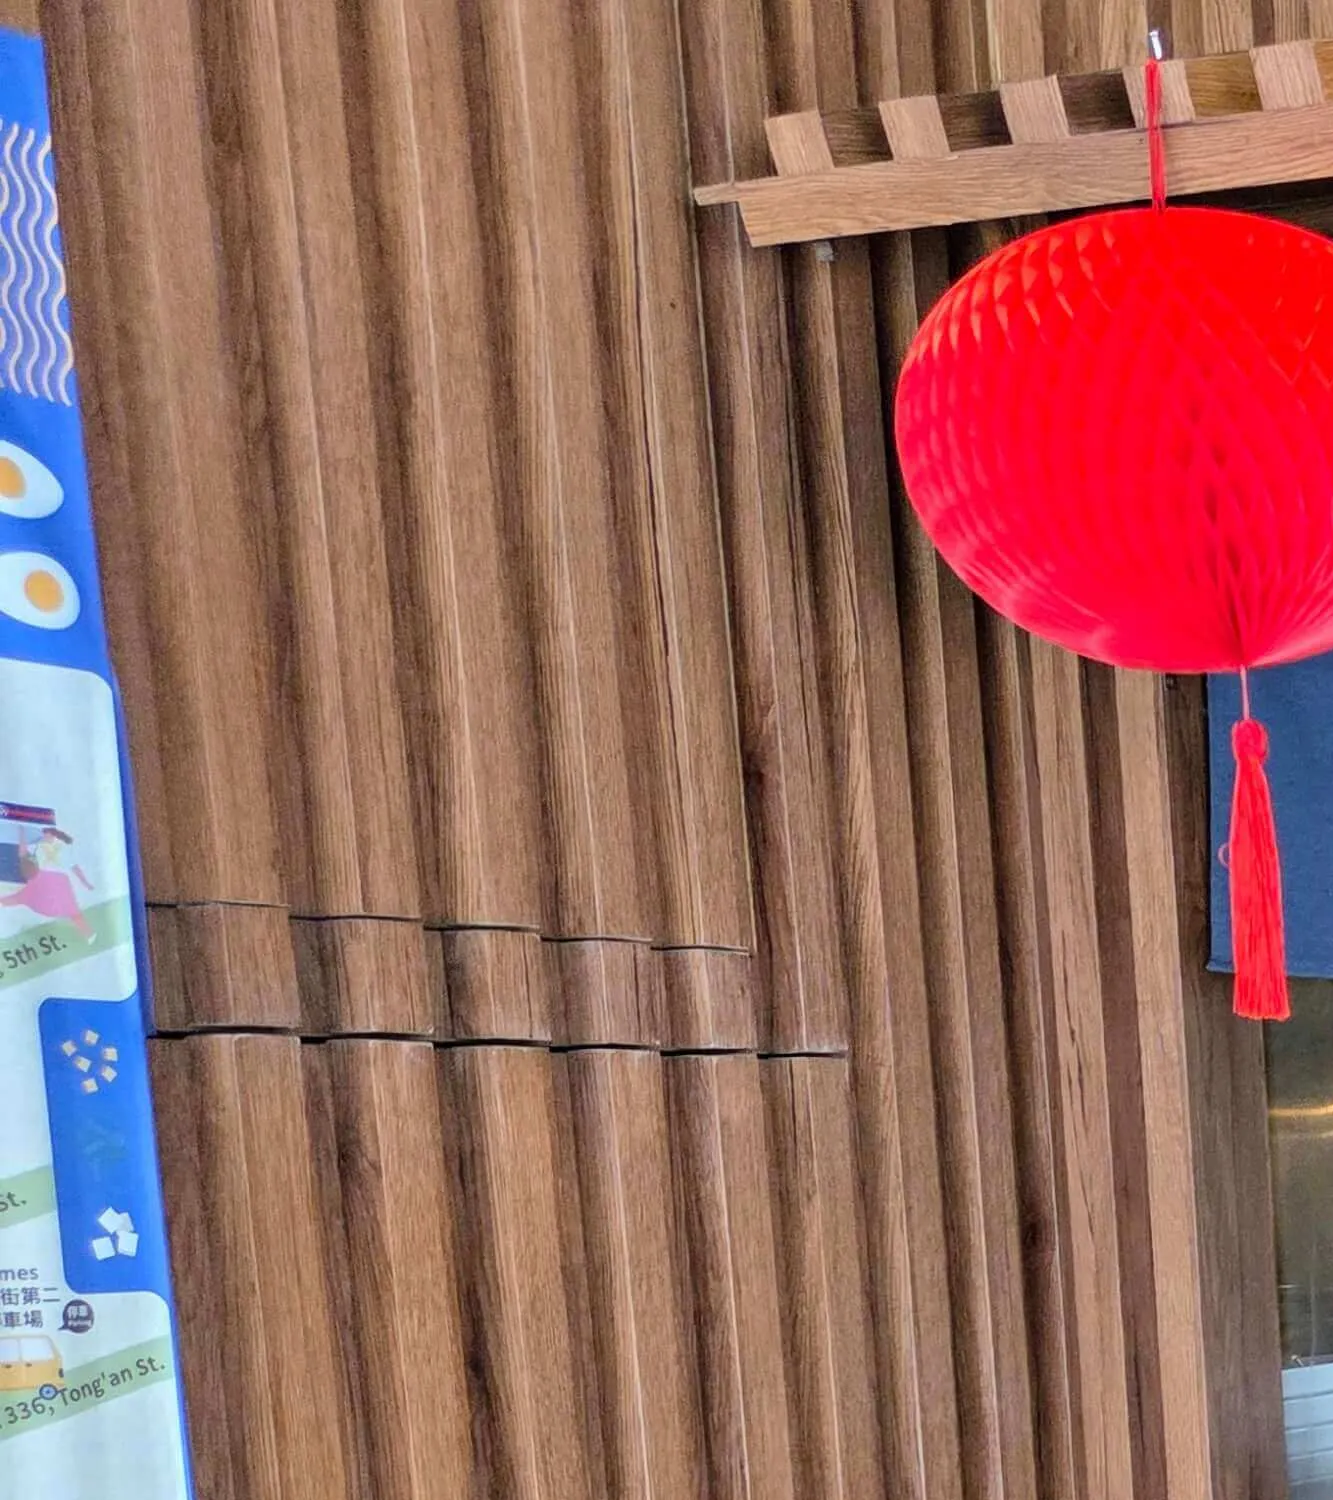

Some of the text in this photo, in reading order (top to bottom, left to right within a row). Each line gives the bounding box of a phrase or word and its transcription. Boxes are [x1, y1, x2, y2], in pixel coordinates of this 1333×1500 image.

[3, 935, 67, 969] 5th St.
[0, 1310, 43, 1328] 車場
[4, 1356, 166, 1426] 336, Tong'an St.
